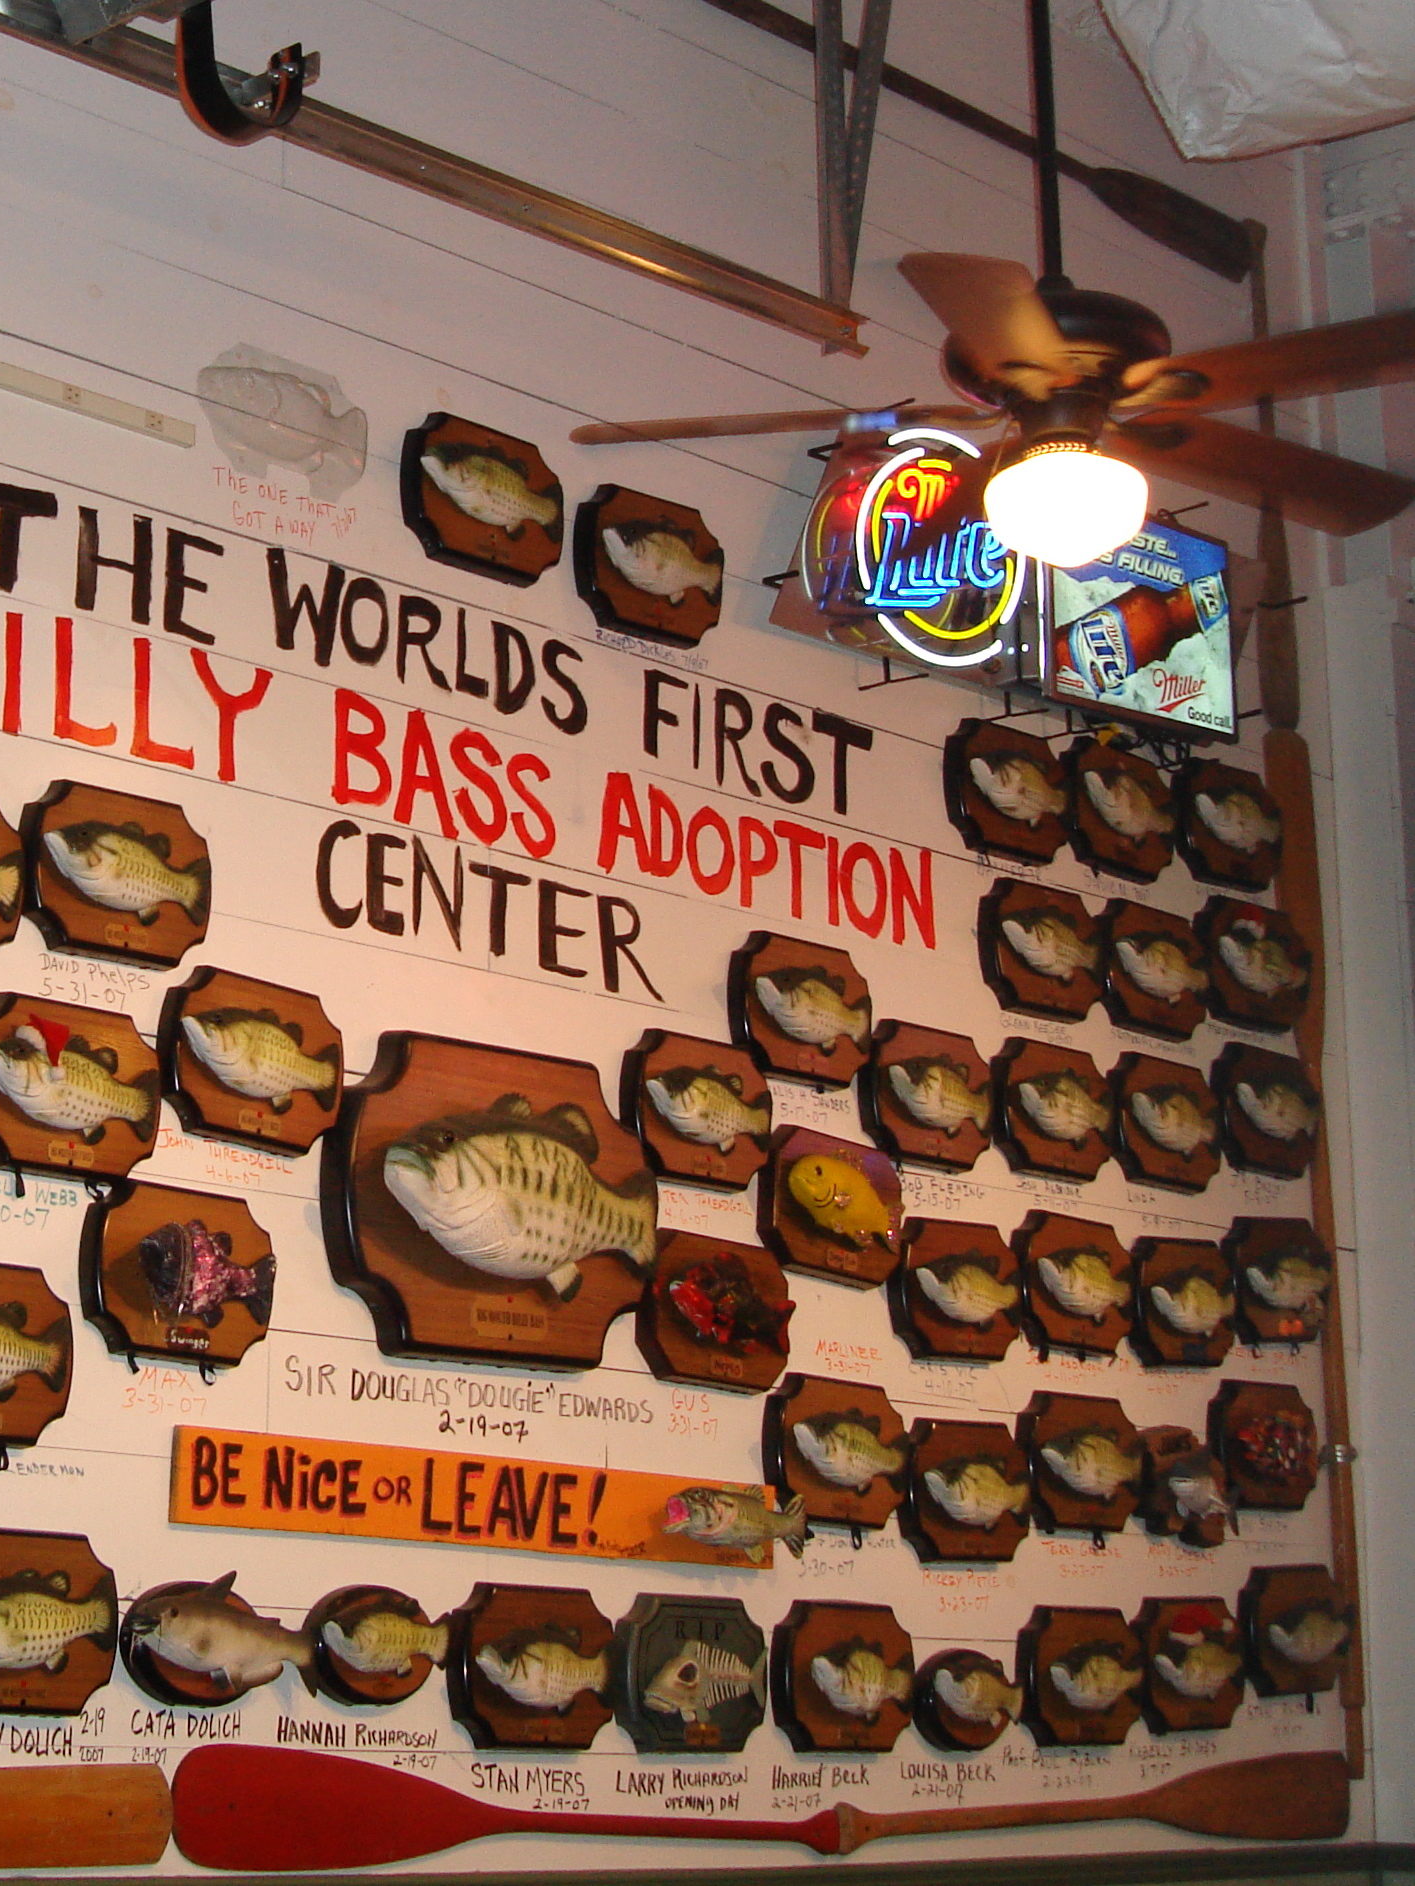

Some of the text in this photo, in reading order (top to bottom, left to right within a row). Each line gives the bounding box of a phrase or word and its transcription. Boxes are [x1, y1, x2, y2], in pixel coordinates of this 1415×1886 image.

[259, 484, 288, 505] ONE
[233, 501, 267, 529] GOT
[267, 547, 587, 736] WORLDS
[643, 668, 873, 814] FIRST
[1152, 668, 1207, 704] Miller
[1187, 705, 1212, 724] Good
[331, 688, 556, 859] BASS
[597, 771, 936, 949] ADOPTION
[316, 818, 666, 1002] CENTER
[40, 953, 79, 976] DAVID
[37, 977, 126, 1011] 5-31-07
[139, 1366, 194, 1392] MAX
[284, 1354, 339, 1397] SIR
[351, 1366, 449, 1408] DOUGLAS
[558, 1392, 654, 1425] EDWARDS
[122, 1387, 207, 1415] 3-31-07
[672, 1389, 710, 1413] GUS
[438, 1410, 529, 1442] 2-19-07
[190, 1435, 246, 1510] BE
[373, 1474, 413, 1505] OR
[420, 1456, 608, 1548] LEAVE!
[130, 1709, 242, 1739] CATA DOLICH
[276, 1715, 438, 1748] HANNAH RICHARDSON
[392, 1753, 437, 1771] 2-19-07
[900, 1763, 997, 1784] LOUISA BECK
[470, 1763, 585, 1798] STAN MYERS
[616, 1765, 748, 1796] LARRY RICHARDSON
[532, 1797, 590, 1812] 2-19-07
[719, 1795, 740, 1811] DAY
